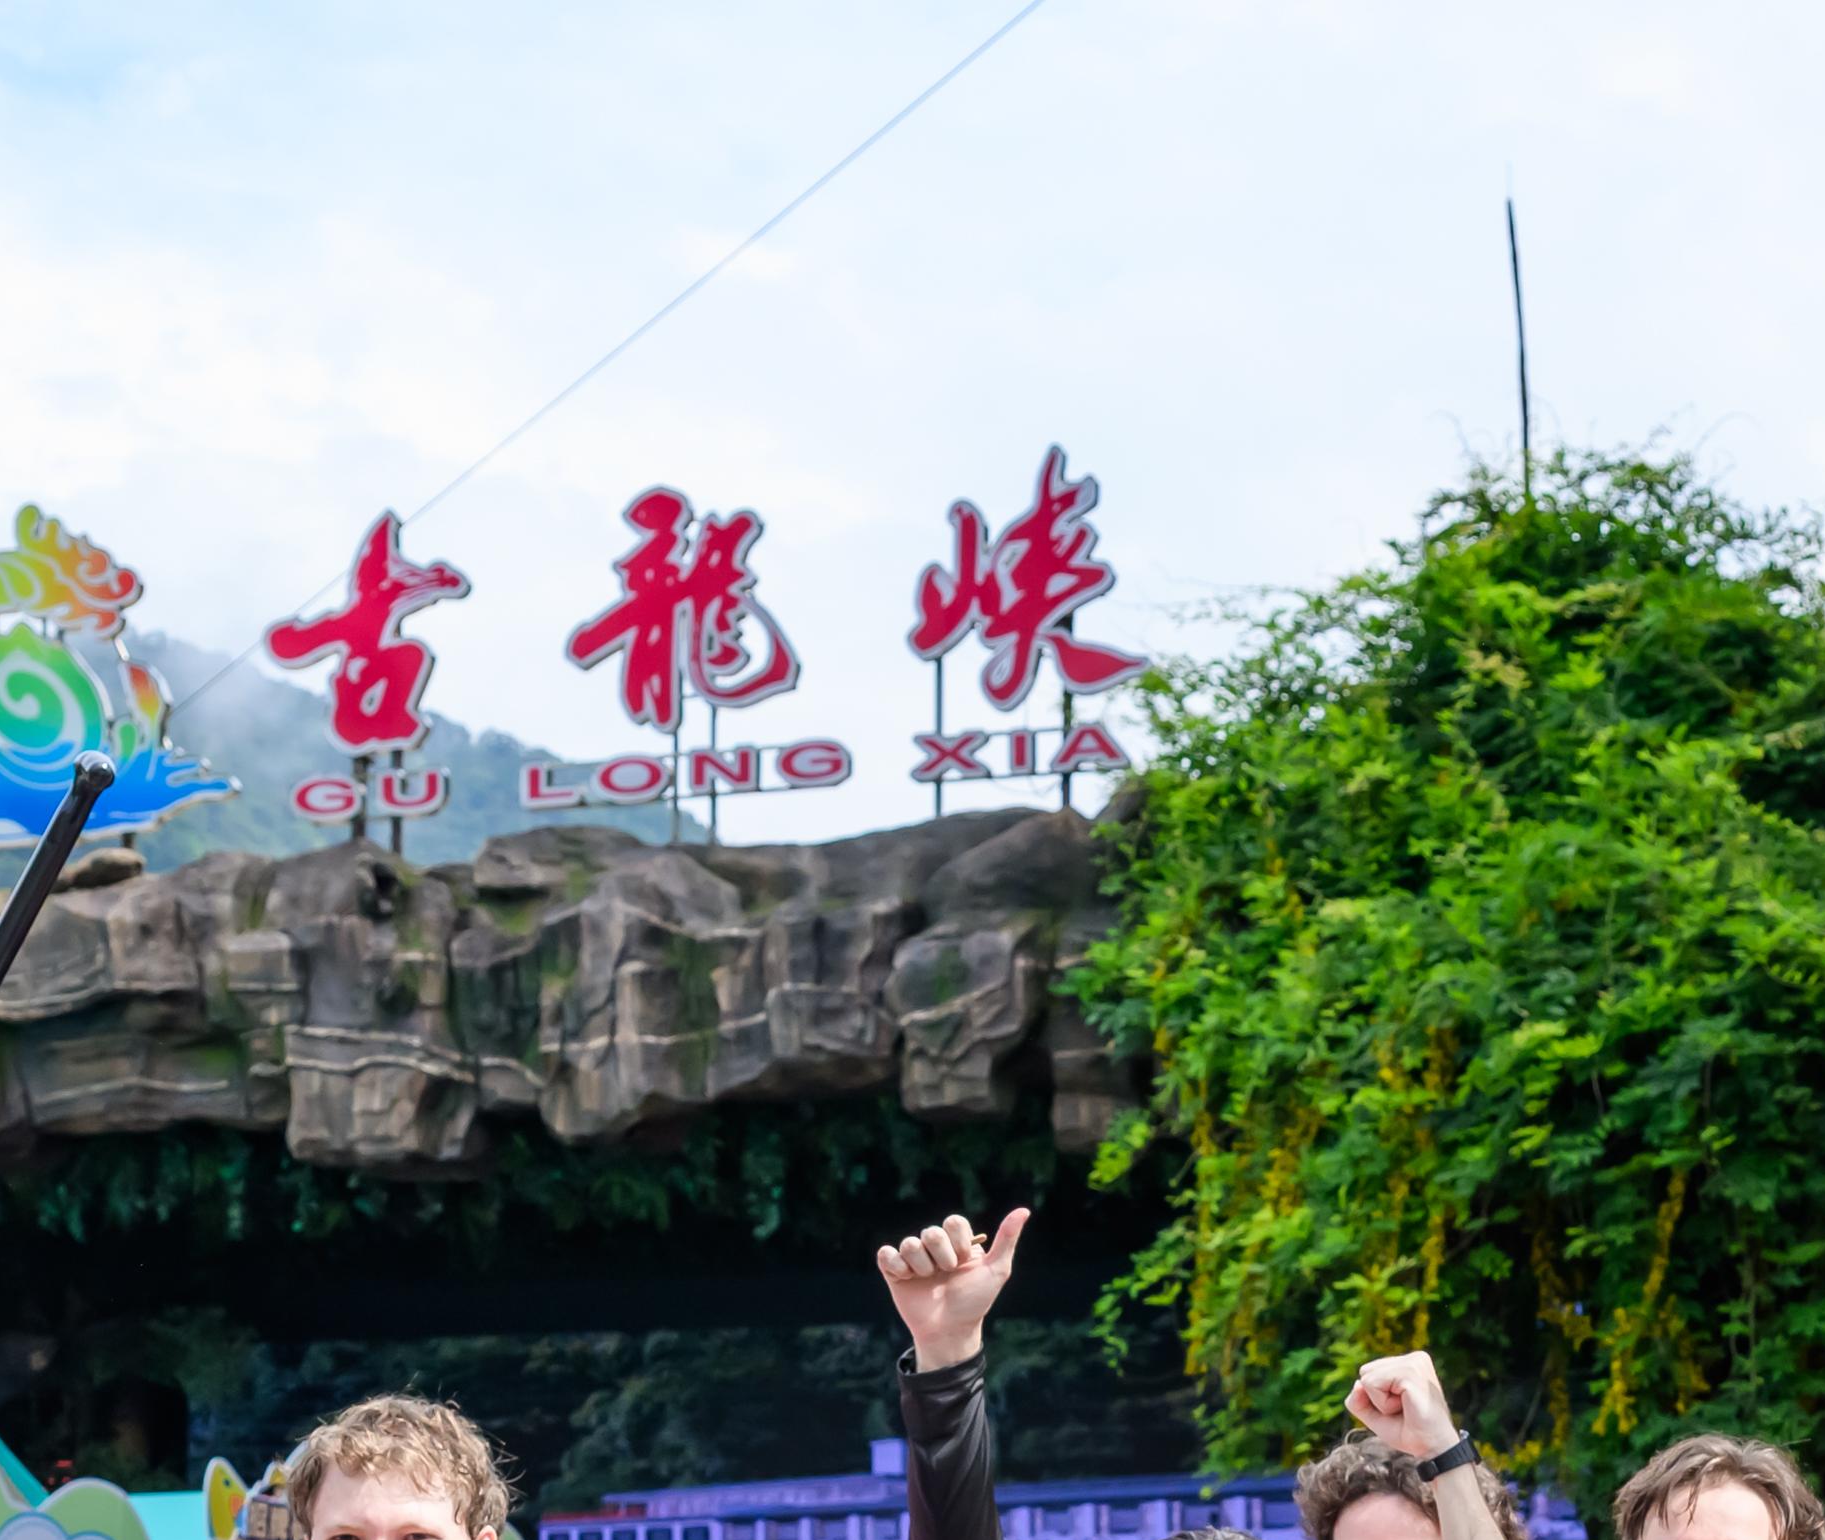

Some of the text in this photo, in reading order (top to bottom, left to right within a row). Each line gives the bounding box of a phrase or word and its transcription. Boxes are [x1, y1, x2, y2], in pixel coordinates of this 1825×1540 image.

[293, 724, 1127, 820] GU LONG XIA
